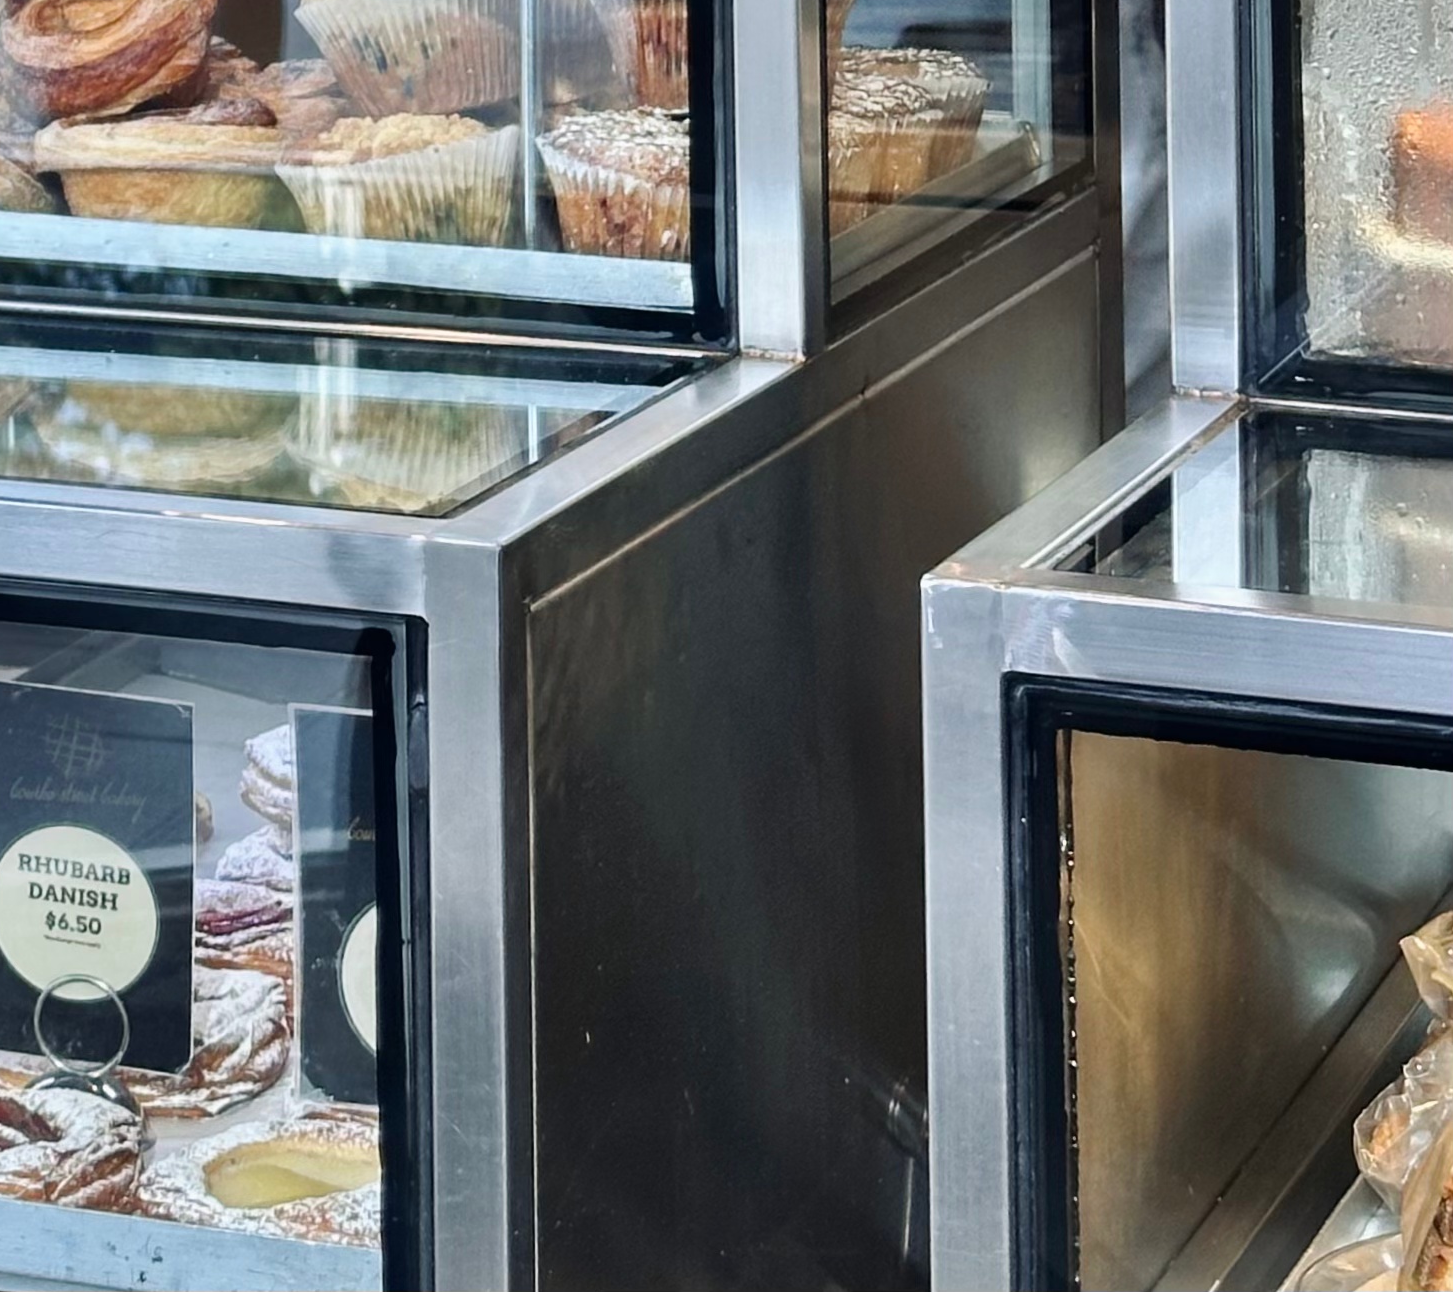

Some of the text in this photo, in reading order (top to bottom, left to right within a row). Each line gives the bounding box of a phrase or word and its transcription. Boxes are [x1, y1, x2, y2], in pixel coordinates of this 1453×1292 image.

[17, 852, 132, 886] RHUBARB
[27, 882, 119, 911] DANISH
[44, 909, 102, 936] $6.50
